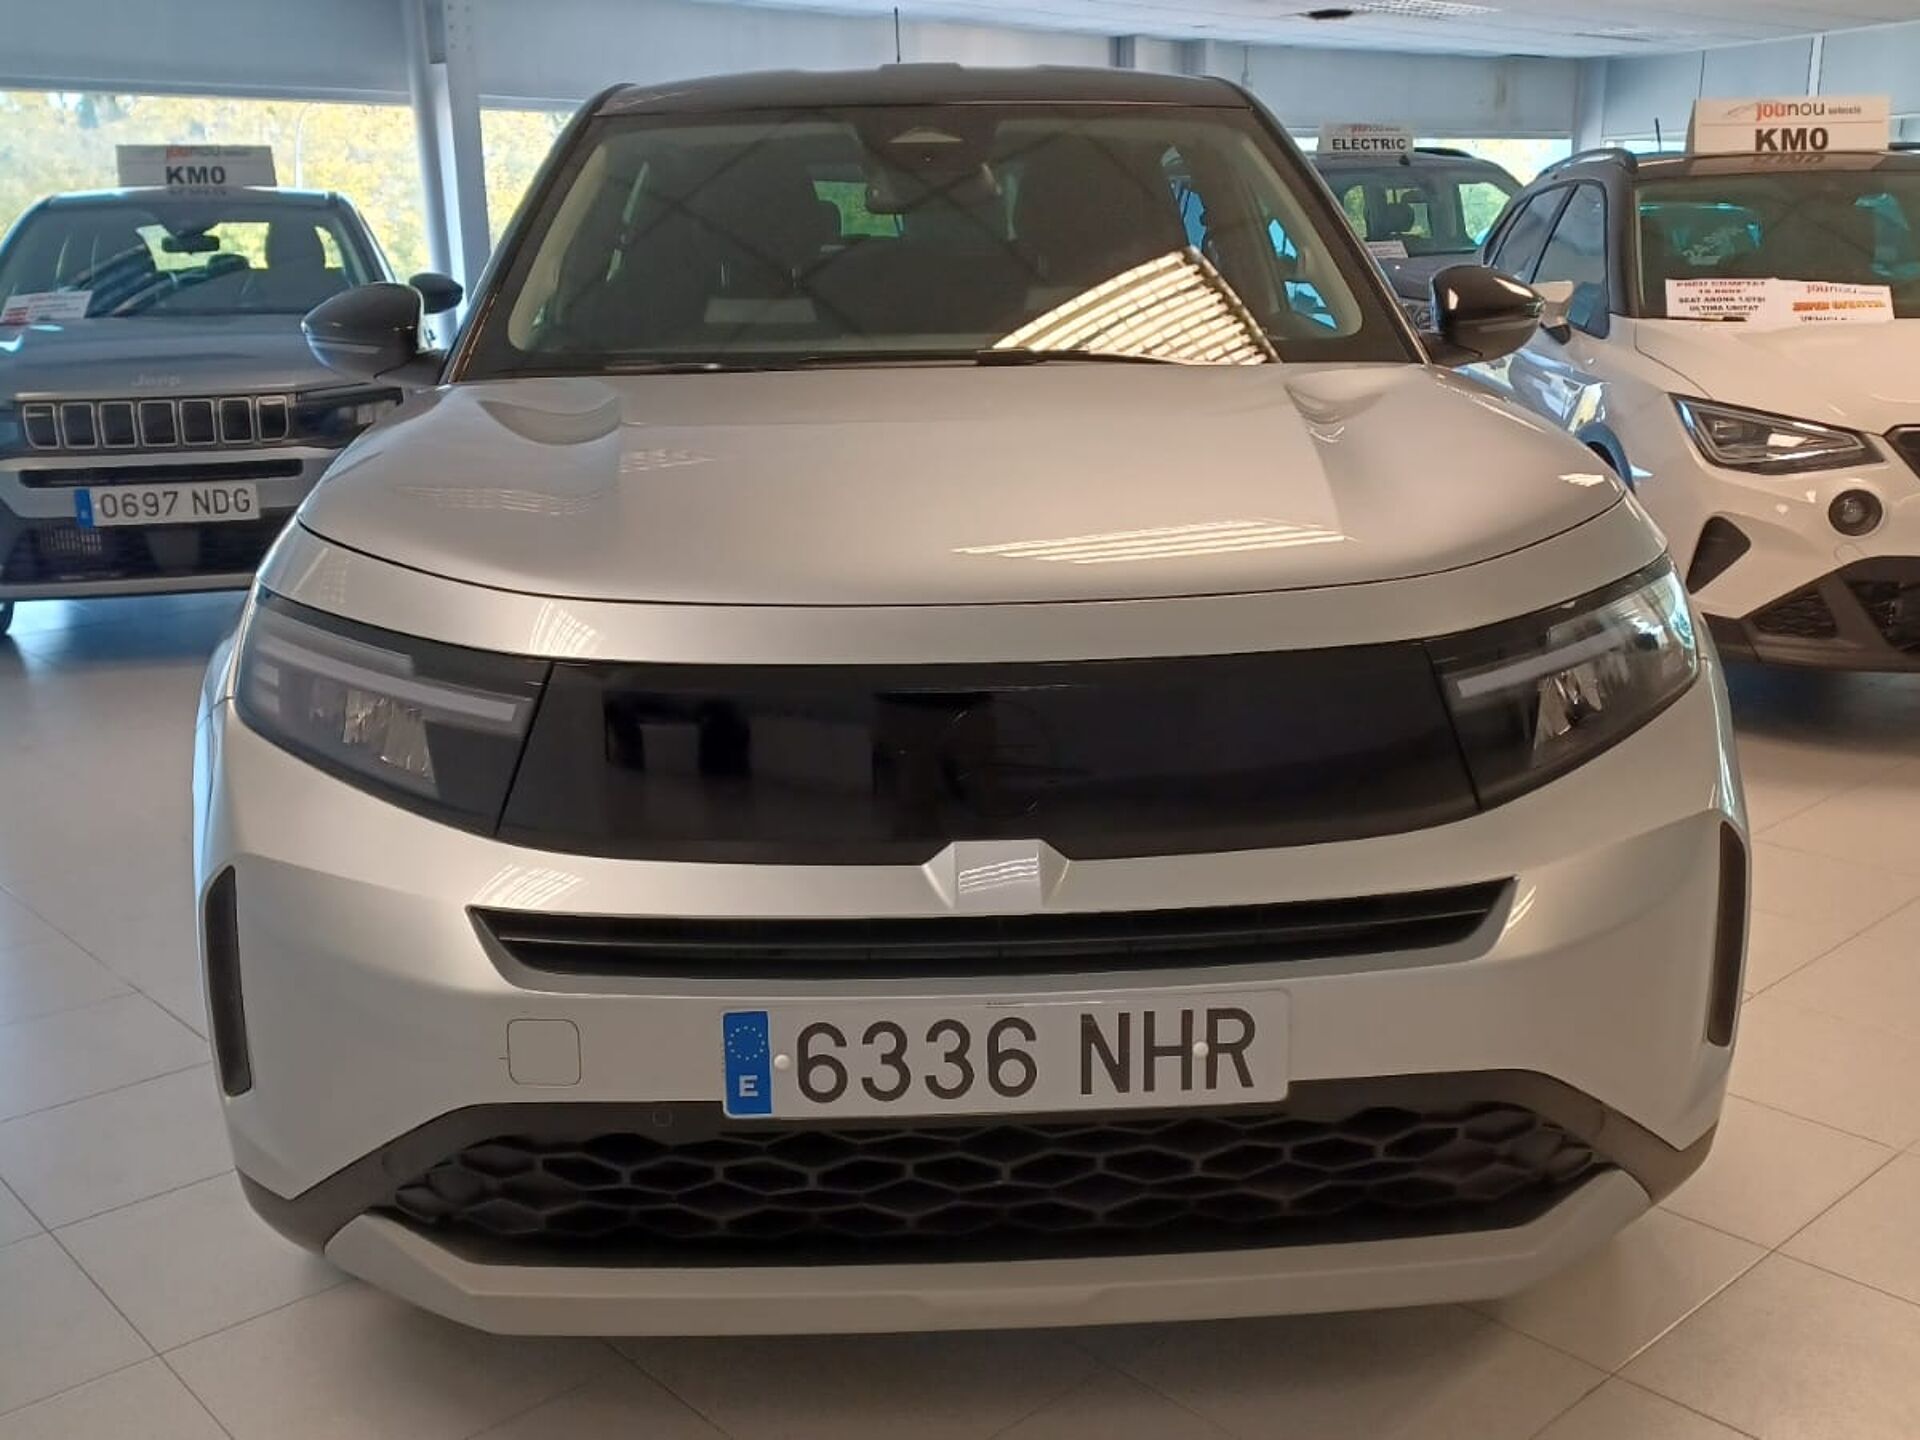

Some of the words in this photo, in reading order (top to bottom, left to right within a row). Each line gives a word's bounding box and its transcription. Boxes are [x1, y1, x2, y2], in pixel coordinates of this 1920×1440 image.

[1756, 102, 1824, 121] jounou
[1332, 138, 1407, 151] ELECTRIC
[1755, 127, 1828, 152] KM0
[165, 165, 226, 185] KM0
[101, 491, 179, 518] 0697
[192, 488, 251, 515] NDG
[796, 1016, 1038, 1103] 6336
[1080, 1006, 1256, 1096] NHR
[739, 1074, 759, 1097] E
